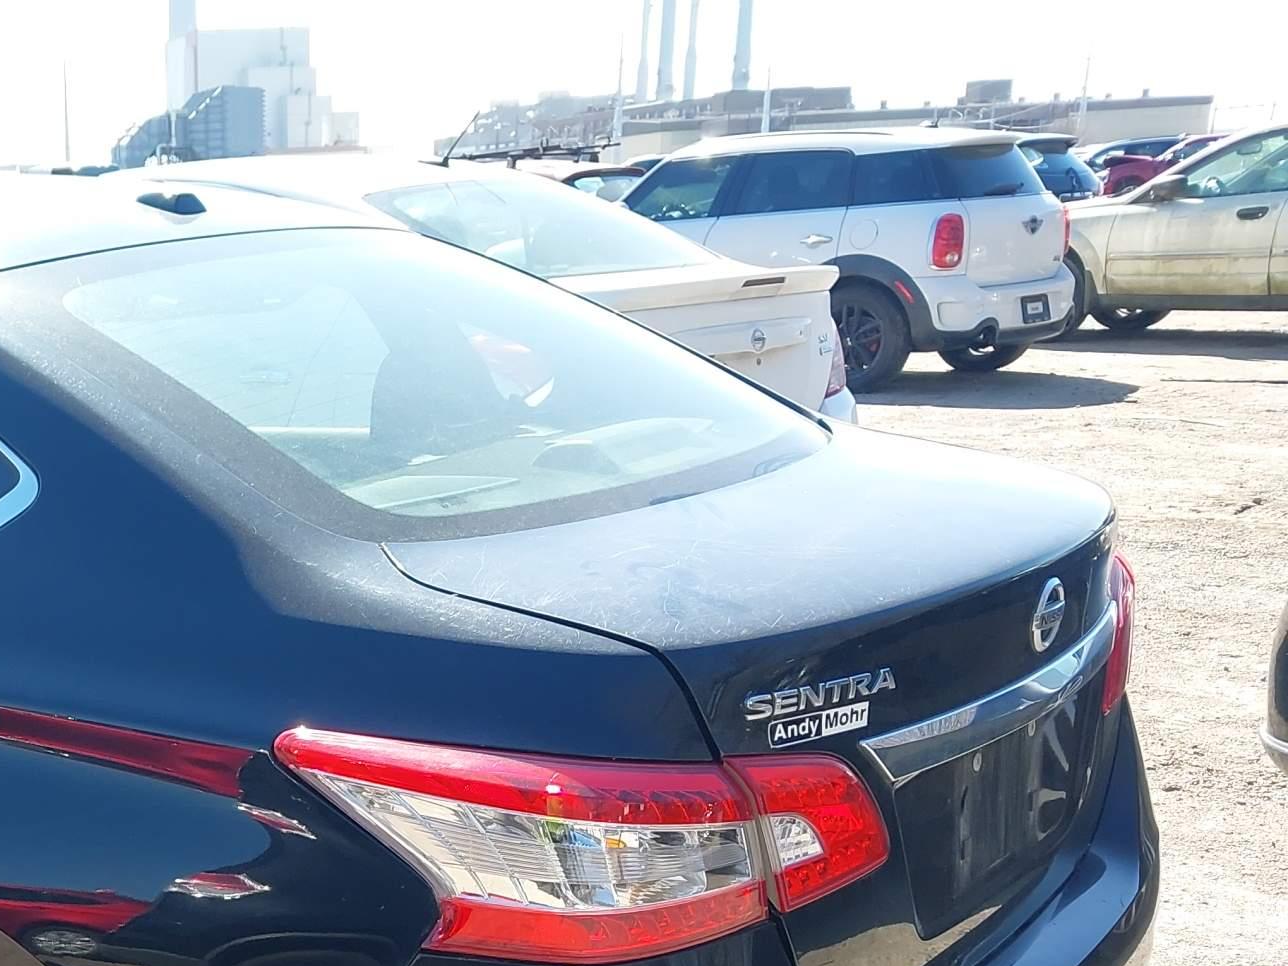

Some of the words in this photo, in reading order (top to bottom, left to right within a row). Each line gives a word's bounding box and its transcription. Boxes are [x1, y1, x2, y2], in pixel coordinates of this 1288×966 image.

[744, 667, 896, 721] SENTRA
[773, 717, 820, 741] Andy
[824, 707, 867, 730] Mohr
